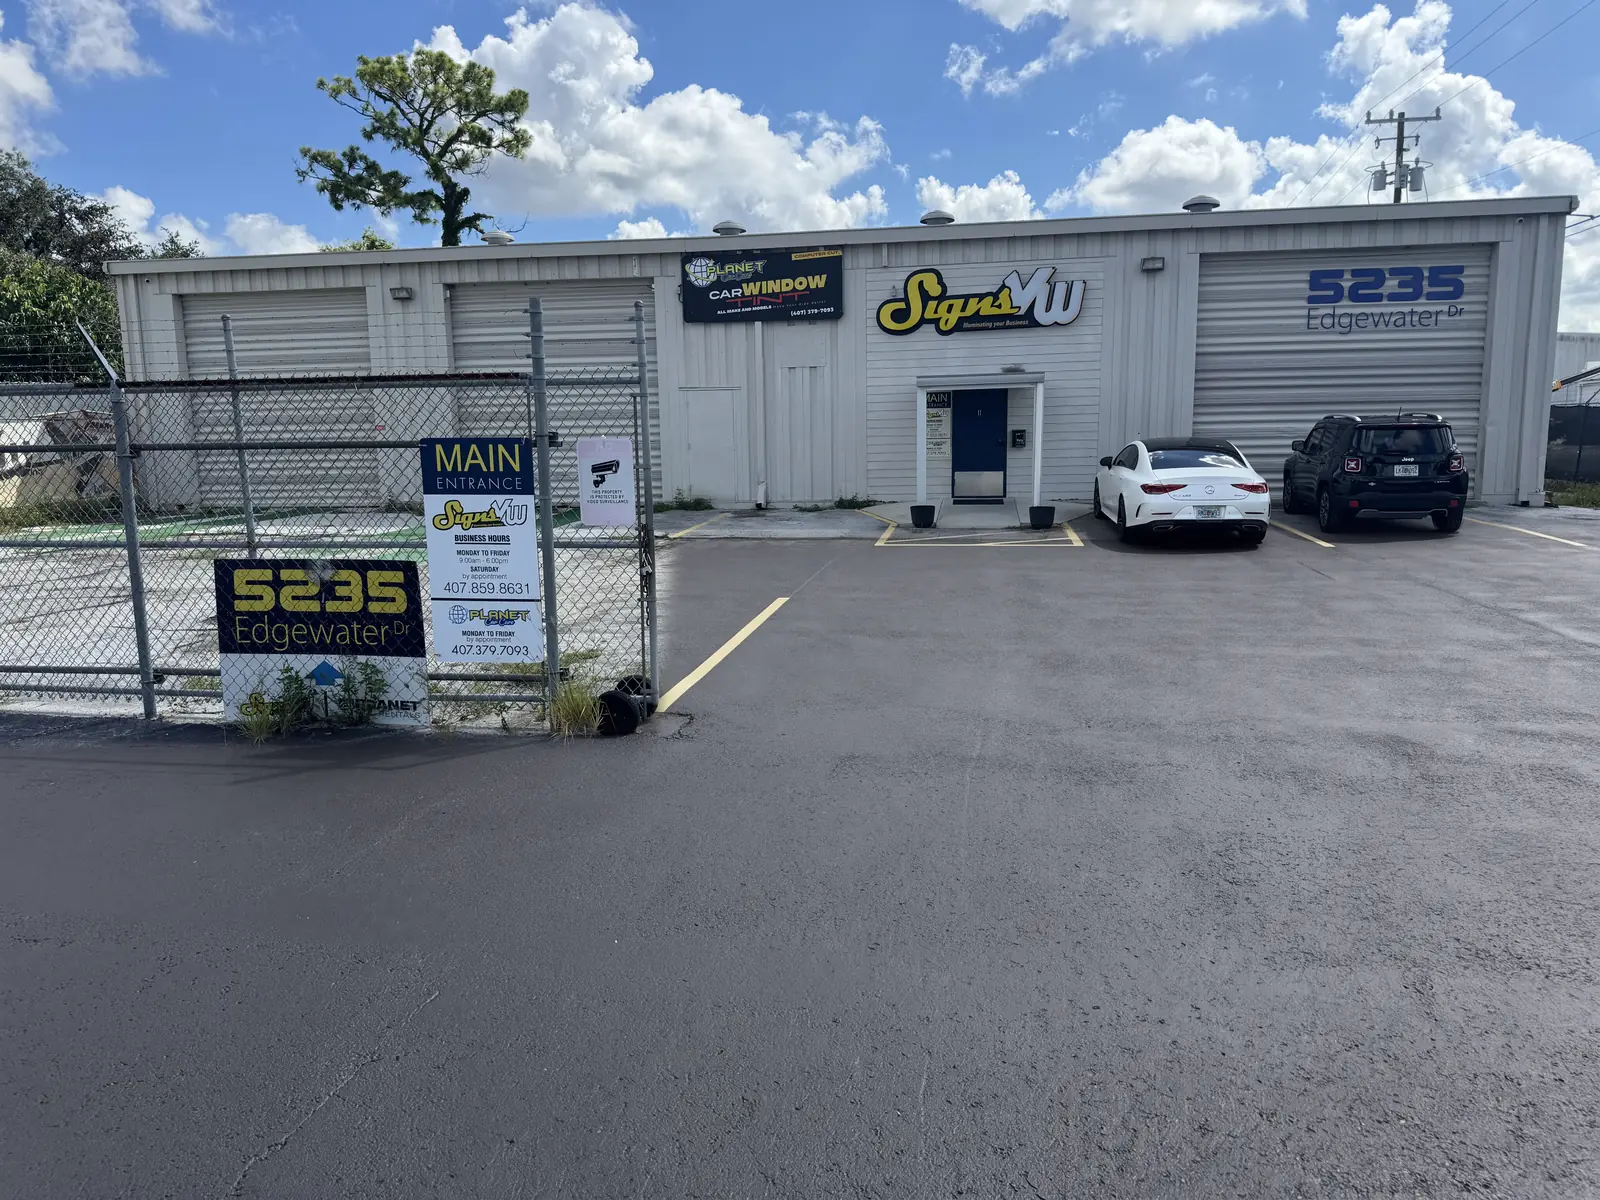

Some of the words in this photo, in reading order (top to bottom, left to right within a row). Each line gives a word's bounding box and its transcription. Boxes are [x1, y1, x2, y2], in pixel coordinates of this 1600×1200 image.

[706, 260, 767, 277] PLANET
[709, 288, 742, 299] CAR
[741, 274, 827, 296] WINDOW
[1307, 265, 1465, 304] 5235
[726, 291, 809, 307] TINT
[790, 309, 807, 317] (407)
[1306, 306, 1443, 335] Edgewater
[1447, 304, 1465, 317] Dr
[993, 320, 1005, 328] your
[435, 444, 520, 472] MAIN
[436, 477, 522, 490] ENTRANCE
[454, 534, 486, 543] BUSINESS
[487, 534, 510, 543] HOURS
[233, 569, 408, 614] 5235
[443, 582, 530, 595] 407.859.8631
[469, 608, 530, 622] PLANET
[235, 615, 389, 651] Edgewater
[393, 620, 410, 635] Dr
[452, 644, 529, 656] 407.379.7093
